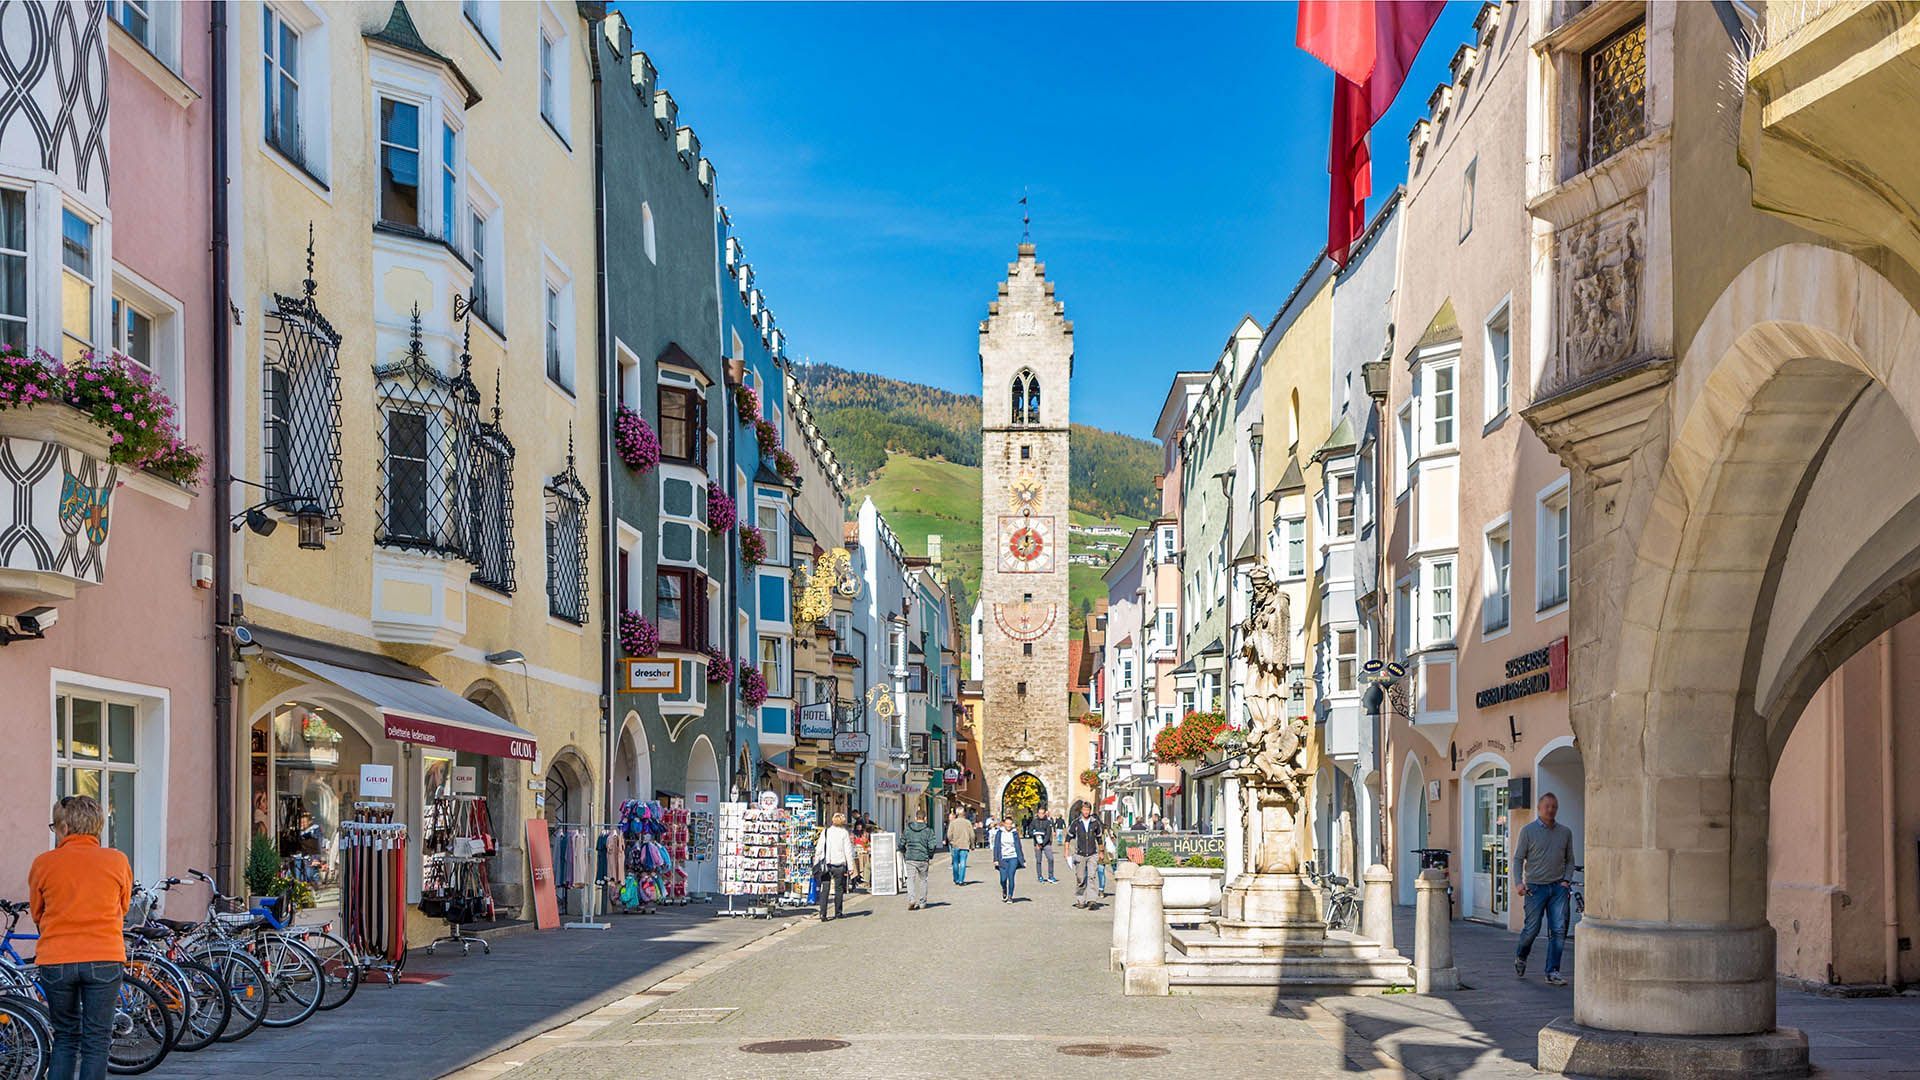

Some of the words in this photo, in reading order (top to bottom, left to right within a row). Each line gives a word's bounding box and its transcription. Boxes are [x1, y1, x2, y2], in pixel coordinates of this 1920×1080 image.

[634, 668, 671, 677] drescher
[803, 709, 831, 721] HOTEL
[510, 740, 532, 759] GIUDI
[842, 740, 863, 748] POST
[1174, 837, 1225, 853] HÄUSLER
